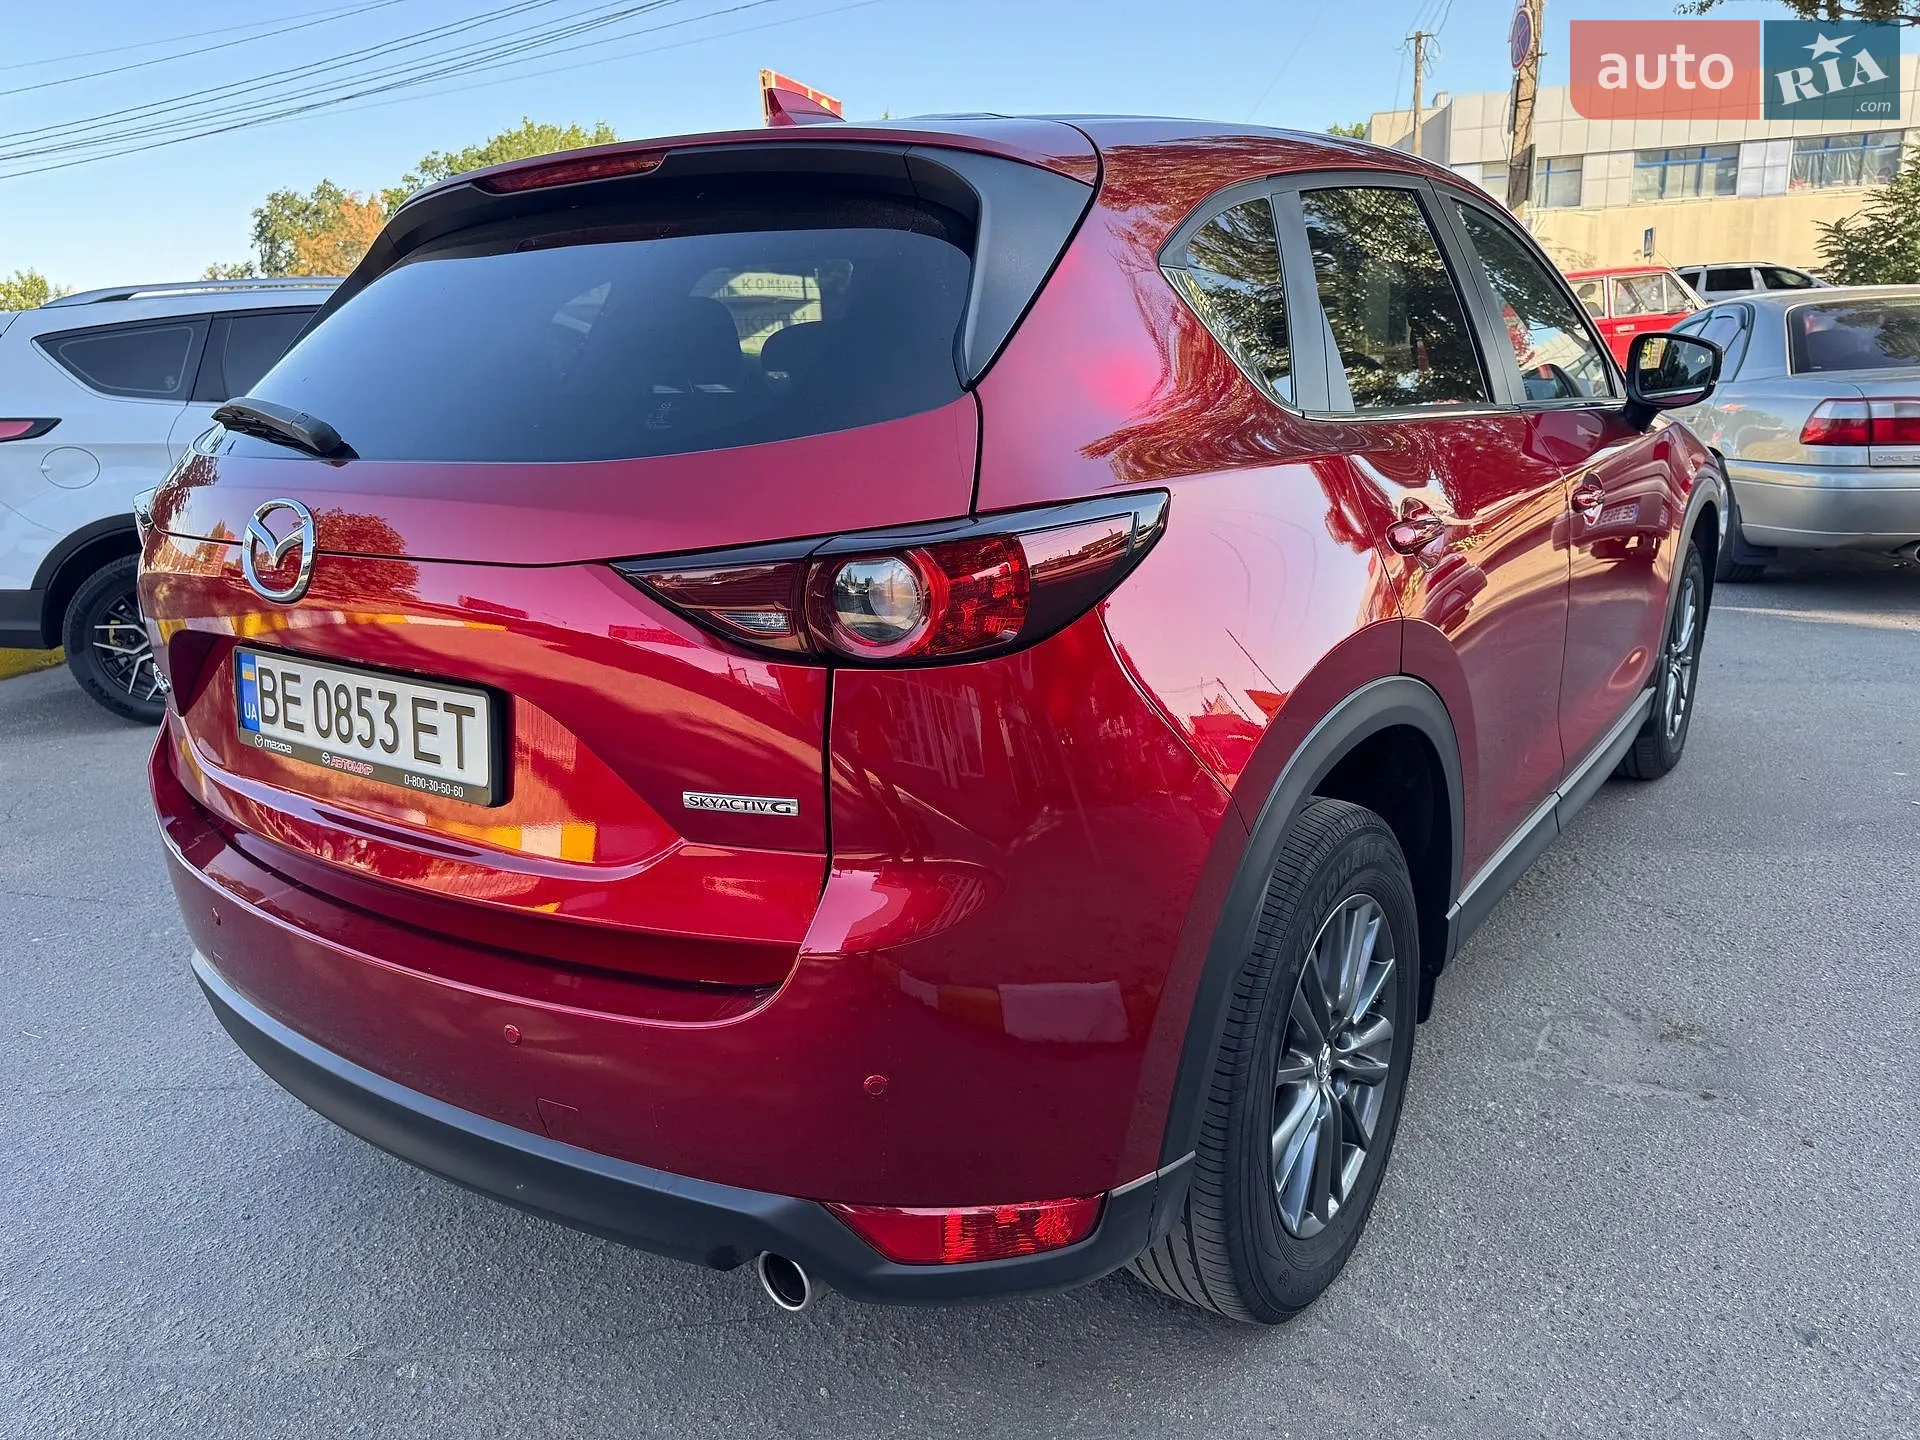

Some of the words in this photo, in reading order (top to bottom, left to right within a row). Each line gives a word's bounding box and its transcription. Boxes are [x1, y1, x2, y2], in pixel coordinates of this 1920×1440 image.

[244, 702, 258, 721] UA
[258, 666, 304, 733] BE
[313, 679, 399, 754] 0853
[411, 697, 476, 770] ET
[403, 774, 464, 798] 0-800-30-50-60
[688, 796, 767, 812] SKYACTIV
